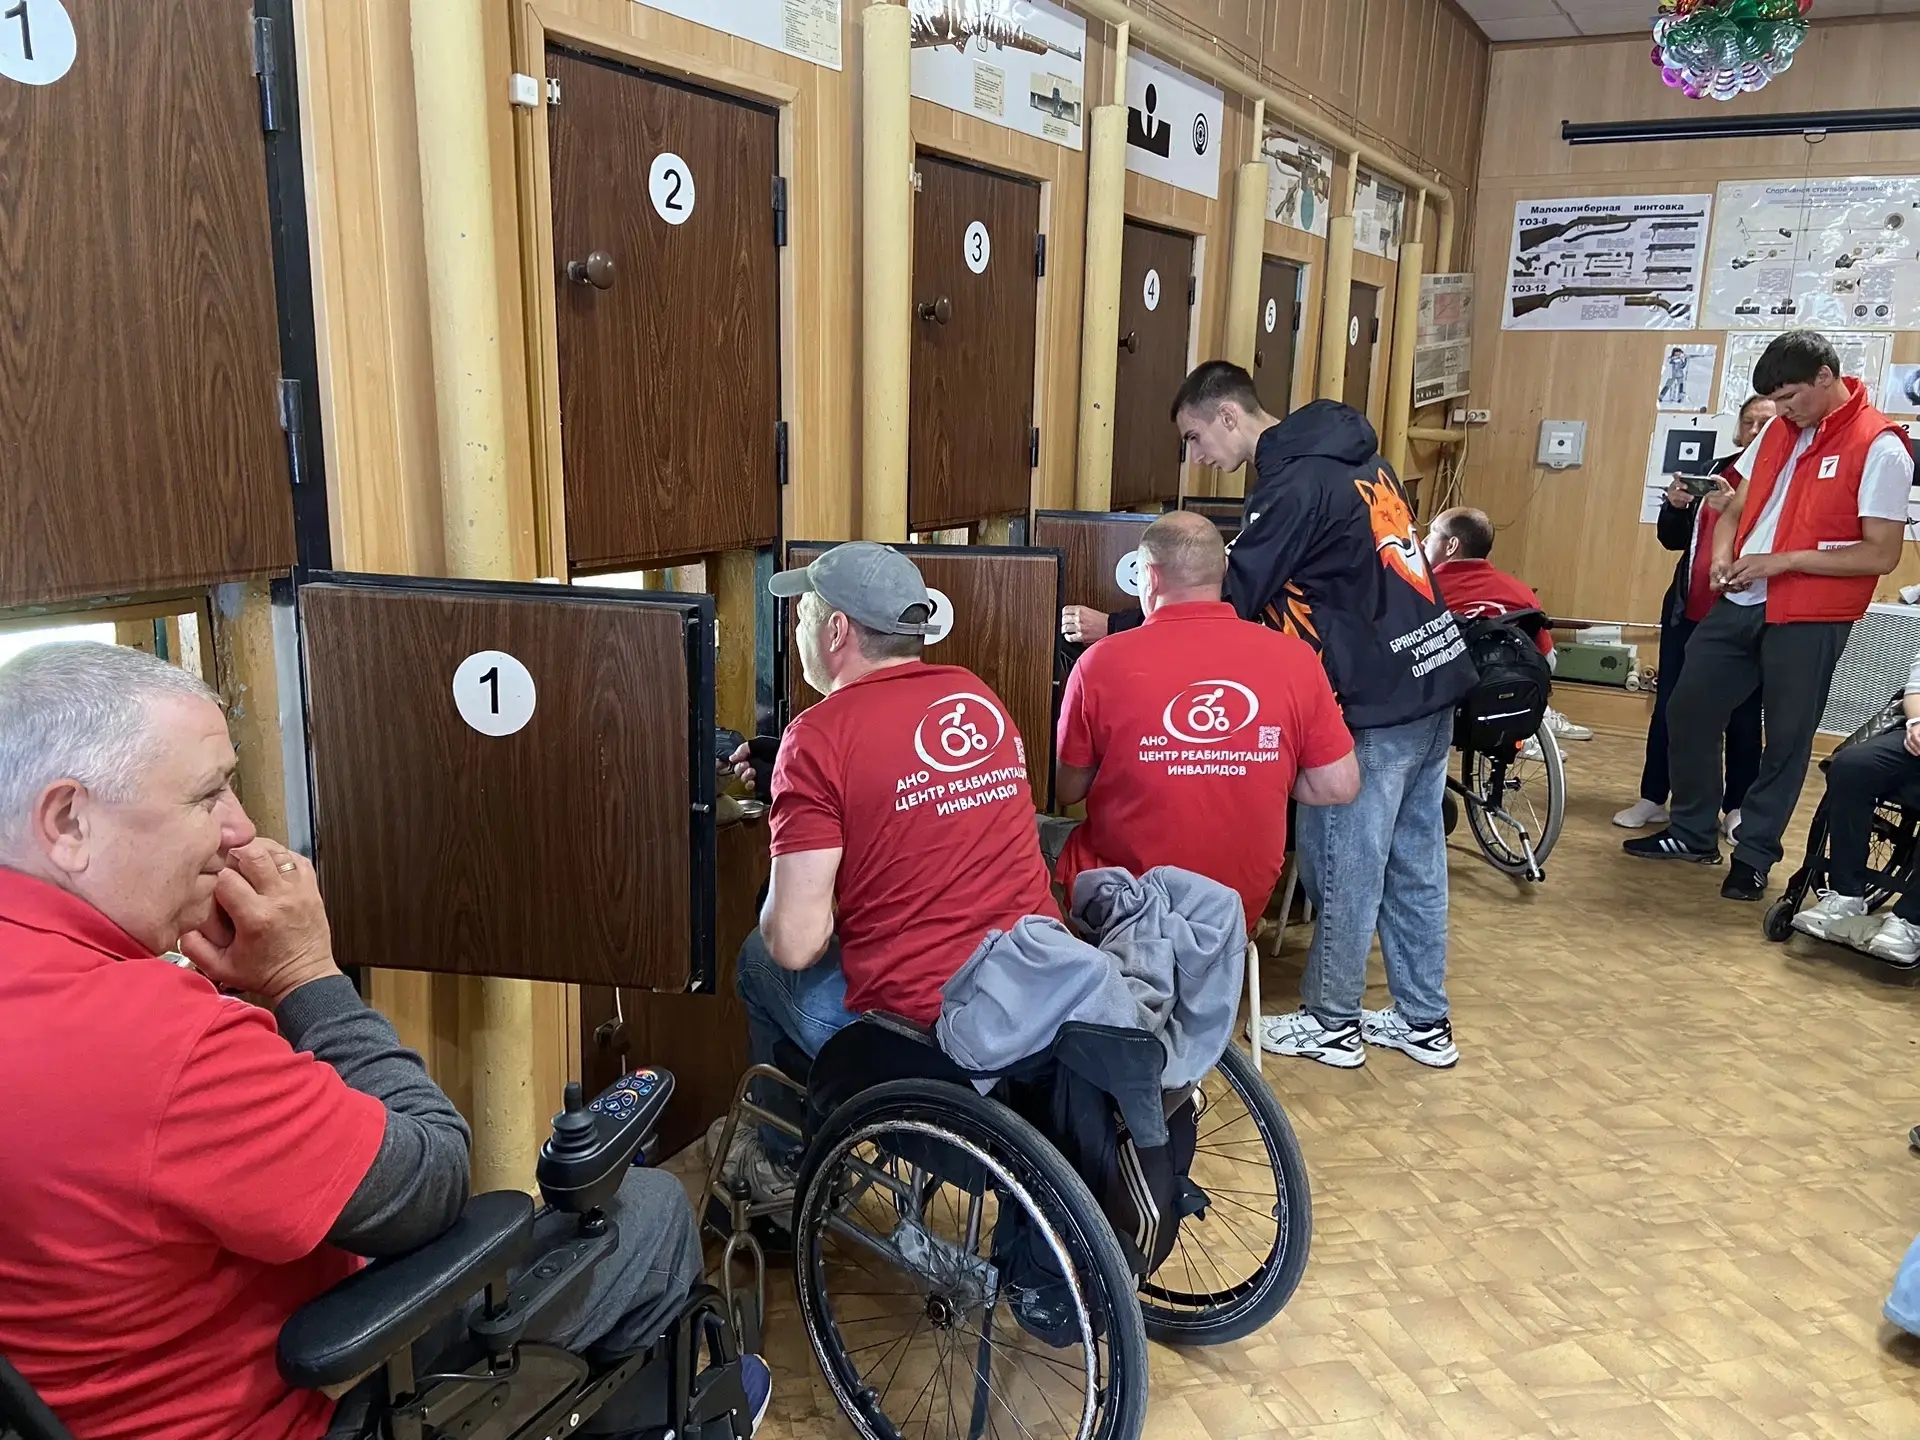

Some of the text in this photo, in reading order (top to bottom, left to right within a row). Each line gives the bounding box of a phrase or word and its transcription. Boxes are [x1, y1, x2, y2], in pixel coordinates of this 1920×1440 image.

[5, 0, 34, 61] 1
[663, 168, 683, 211] 2
[1530, 203, 1684, 214] Малокалиберная винтовка
[1519, 218, 1548, 226] ТОЗ-8
[972, 231, 983, 263] 3
[1147, 277, 1155, 301] 4
[1512, 284, 1547, 293] ТОЗ-12
[1267, 306, 1274, 326] 5
[1351, 322, 1358, 339] 6
[1691, 416, 1698, 427] 1
[479, 666, 499, 715] 1
[1139, 735, 1169, 747] АНО
[1139, 749, 1279, 763] ЦЕНТР РЕАБИЛИТАЦИИ
[1167, 764, 1247, 776] ИНВАЛИДОВ
[896, 770, 930, 794] АНО
[895, 785, 946, 812] ЦЕНТР
